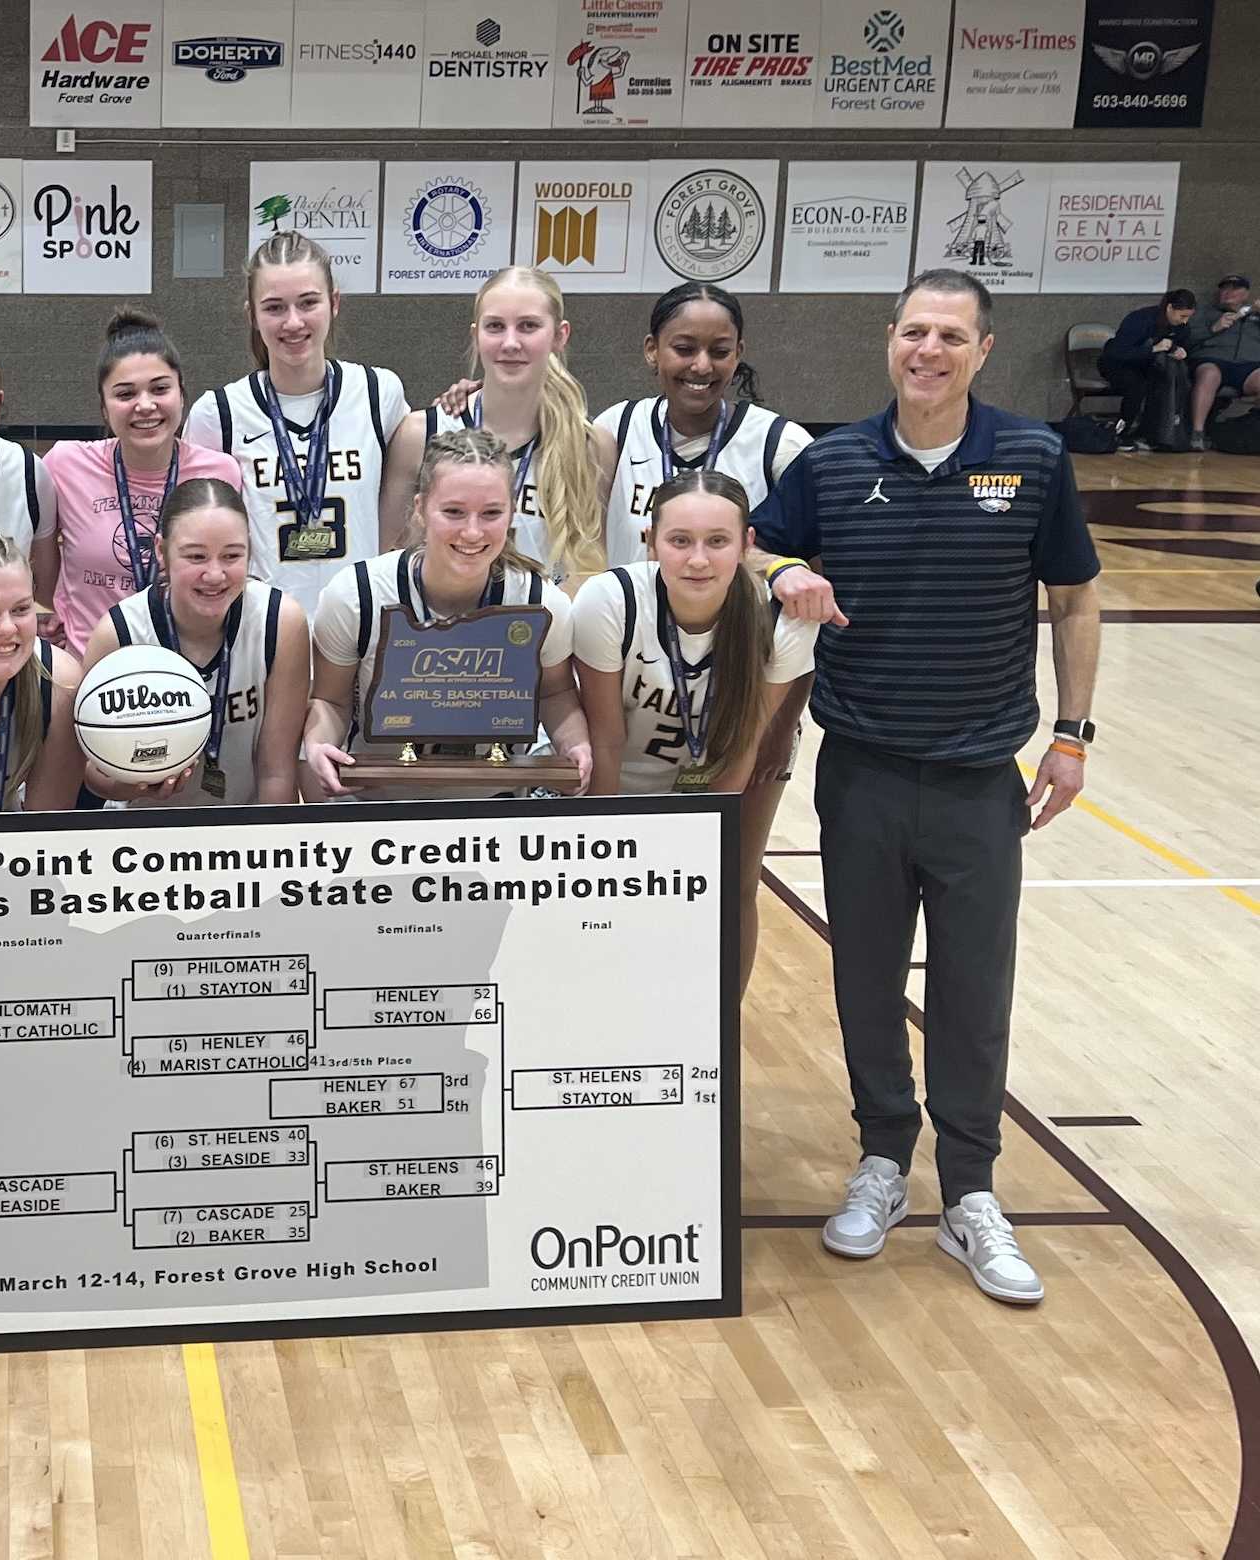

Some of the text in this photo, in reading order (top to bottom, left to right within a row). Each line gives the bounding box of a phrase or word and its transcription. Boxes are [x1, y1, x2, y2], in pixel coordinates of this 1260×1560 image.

[41, 13, 152, 63] ACE
[708, 34, 800, 54] ON SITE
[960, 28, 1076, 50] News-Times
[178, 45, 277, 60] DOHERTY
[451, 51, 528, 59] MICHAEL MINOR
[213, 68, 239, 80] Ford
[429, 60, 549, 78] DENTISTRY
[690, 56, 813, 76] TIRE PROS
[831, 55, 932, 77] BestMed
[42, 70, 150, 91] Hardware
[824, 77, 936, 94] URGENT CARE
[59, 93, 132, 105] Forest Grove
[831, 97, 925, 111] Forest Grove
[1093, 94, 1187, 108] 503-840-5696
[535, 182, 632, 198] WOODFOLD
[667, 178, 757, 219] FOREST GROVE
[34, 184, 139, 237] Pink
[1058, 195, 1165, 211] RESIDENTIAL
[293, 211, 371, 229] DENTAL
[791, 206, 908, 225] ECON-O-FAB
[1056, 220, 1162, 237] RENTAL
[42, 236, 131, 259] SPOON
[1055, 245, 1160, 262] GROUP LLC
[389, 270, 461, 279] FOREST GROVE
[969, 475, 1021, 487] STAYTON
[973, 486, 1016, 498] EAGLES
[412, 648, 504, 677] OSAA
[98, 684, 193, 716] Wilson
[380, 690, 532, 700] 4A GIRLS BASKETBALL
[431, 700, 482, 709] CHAMPION
[112, 841, 353, 875] Community
[371, 837, 500, 867] Credit
[520, 833, 638, 861] Union
[31, 881, 260, 916] Basketball
[280, 878, 393, 907] State
[412, 869, 708, 906] Championship
[377, 923, 443, 935] Semifinals
[581, 920, 612, 930] Final
[177, 929, 261, 942] Quarterfinals
[153, 958, 306, 977] (9) PHILOMATH 26
[166, 979, 306, 998] (1) STAYTON 41
[376, 988, 491, 1004] HENLEY 52
[374, 1008, 492, 1024] STAYTON 66
[168, 1034, 305, 1053] (5) HENLEY 46
[160, 1059, 221, 1073] MARIST
[226, 1056, 307, 1071] CATHOLIC
[310, 1055, 326, 1067] 41
[329, 1056, 412, 1067] 3rd/5th Place
[552, 1067, 718, 1083] ST. HELENS 26 2nd
[324, 1075, 469, 1093] HENLEY 67 3rd
[562, 1089, 716, 1105] STAYTON 34 1st
[326, 1098, 469, 1114] BAKER 51 5th
[368, 1159, 493, 1176] ST. HELENS 46
[385, 1181, 493, 1196] BAKER 39
[531, 1224, 699, 1270] OnPoint
[0, 1258, 438, 1293] March 12-14, Forest Grove High School
[531, 1271, 700, 1291] COMMUNITY CREDIT UNION
